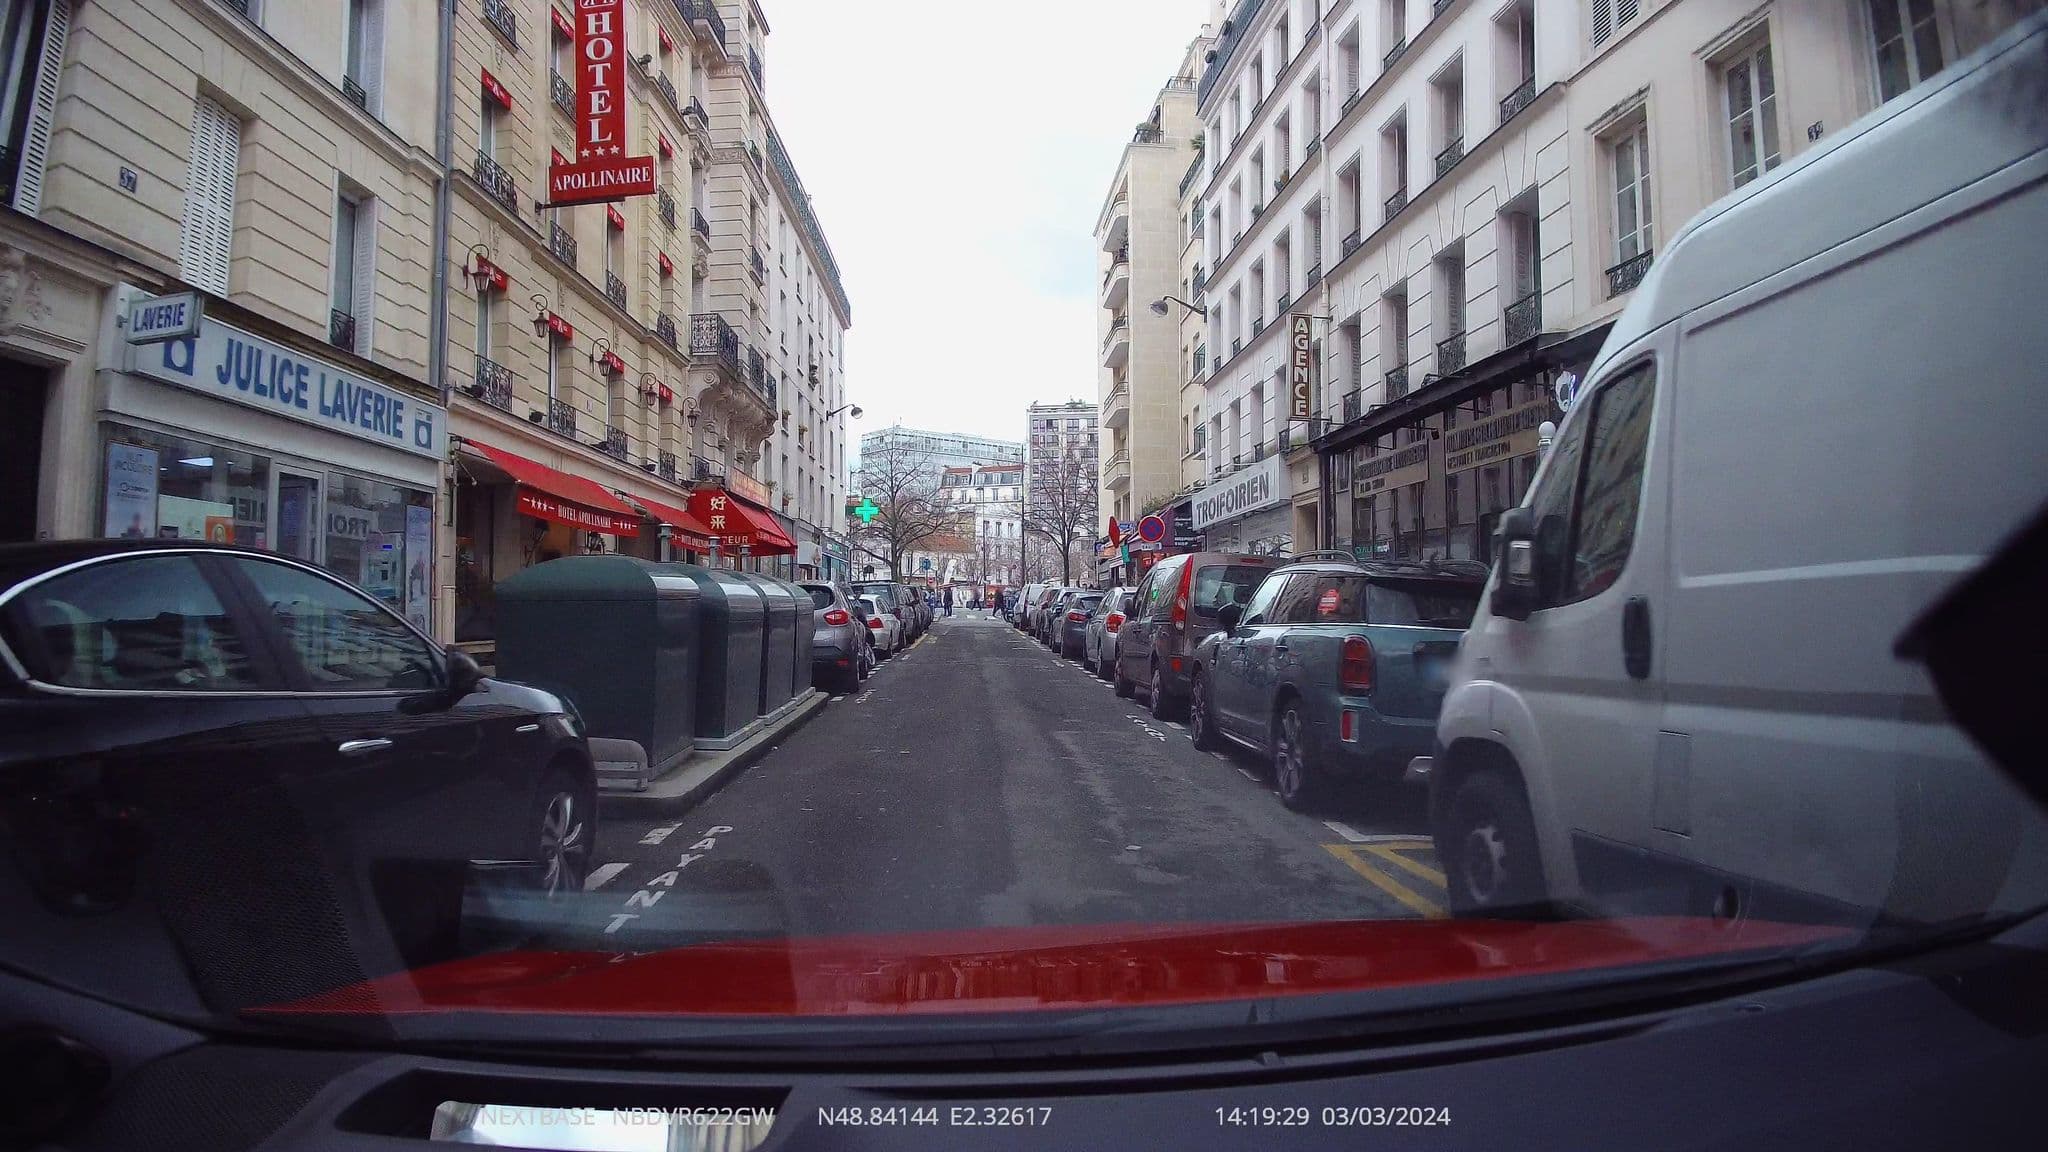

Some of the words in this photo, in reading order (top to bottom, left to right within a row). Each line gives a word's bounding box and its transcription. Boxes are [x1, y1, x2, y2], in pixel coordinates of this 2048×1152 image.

[585, 11, 614, 144] HOTEL
[552, 166, 651, 192] APOLLINAIRE
[133, 301, 185, 333] LAVERIE
[215, 337, 309, 411] JULICE
[317, 371, 404, 440] LAVERIE
[1294, 317, 1309, 416] AGENCE
[558, 504, 577, 521] HOTEL
[1196, 471, 1271, 527] TROIFOIRIEN
[603, 825, 734, 934] PAYANT
